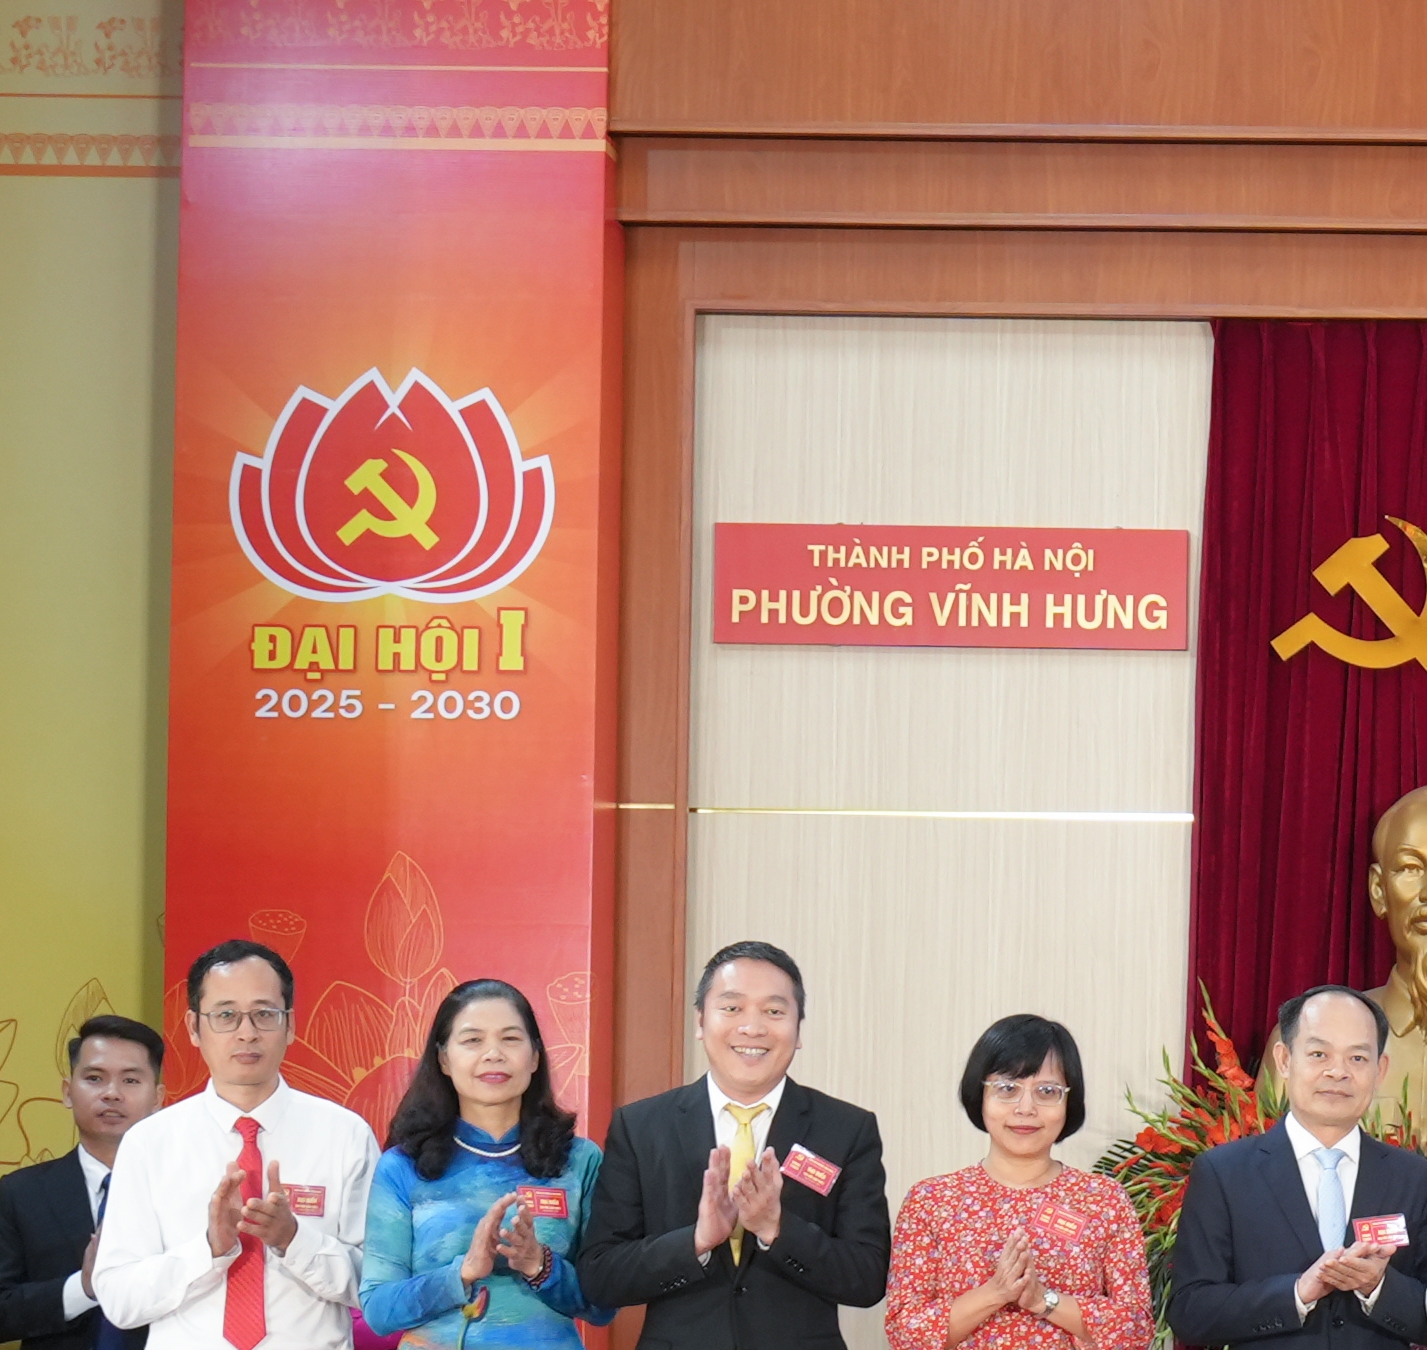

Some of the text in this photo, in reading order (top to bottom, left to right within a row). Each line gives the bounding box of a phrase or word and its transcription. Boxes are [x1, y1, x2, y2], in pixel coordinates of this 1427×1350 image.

[807, 536, 1095, 578] THÀNH PHỐ HÀ NỘI
[730, 576, 1169, 631] PHƯỜNG VĨNH HƯNG
[251, 609, 526, 682] ĐẠI HỘI I
[254, 687, 364, 719] 2025
[409, 689, 521, 720] 2030
